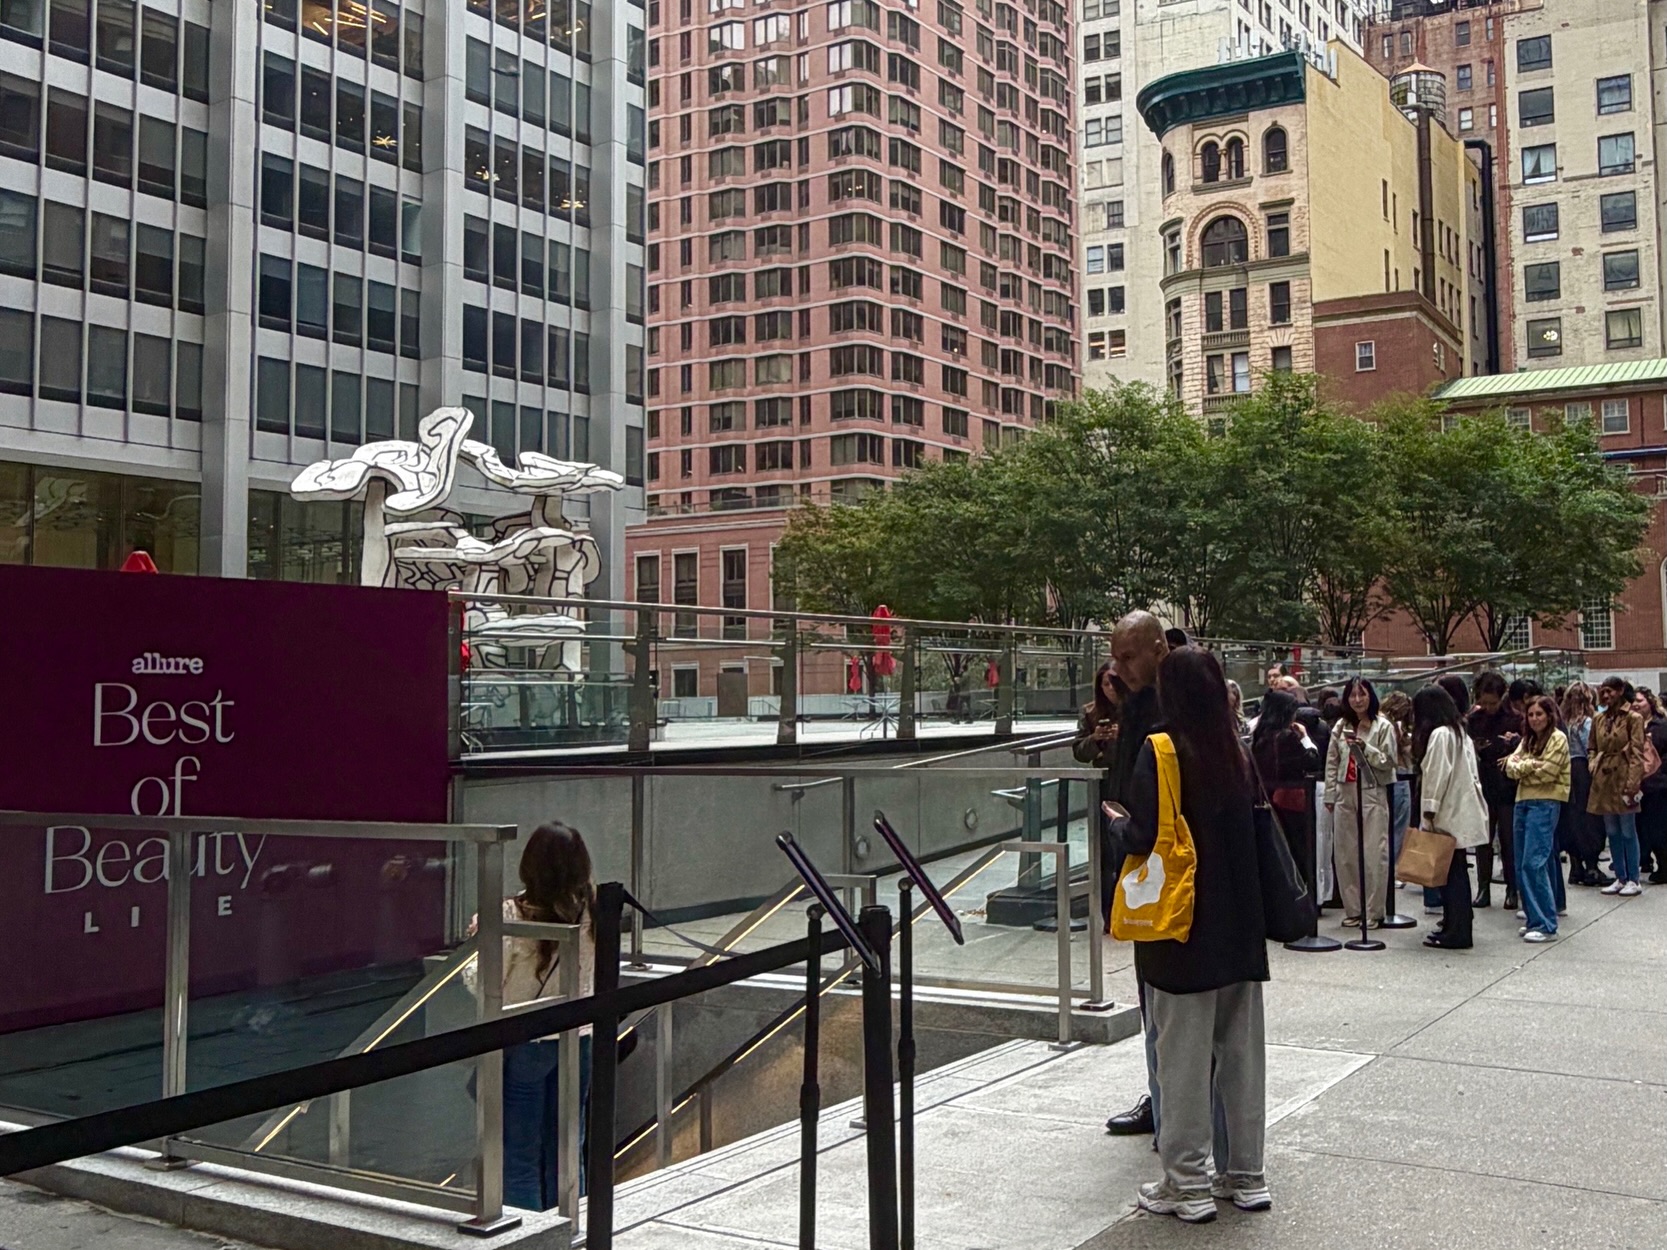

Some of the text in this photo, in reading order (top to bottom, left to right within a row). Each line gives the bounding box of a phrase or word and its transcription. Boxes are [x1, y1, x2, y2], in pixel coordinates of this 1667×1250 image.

[131, 652, 204, 675] allure
[93, 682, 234, 747] Best
[131, 755, 201, 817] of
[83, 895, 233, 934] LIE
